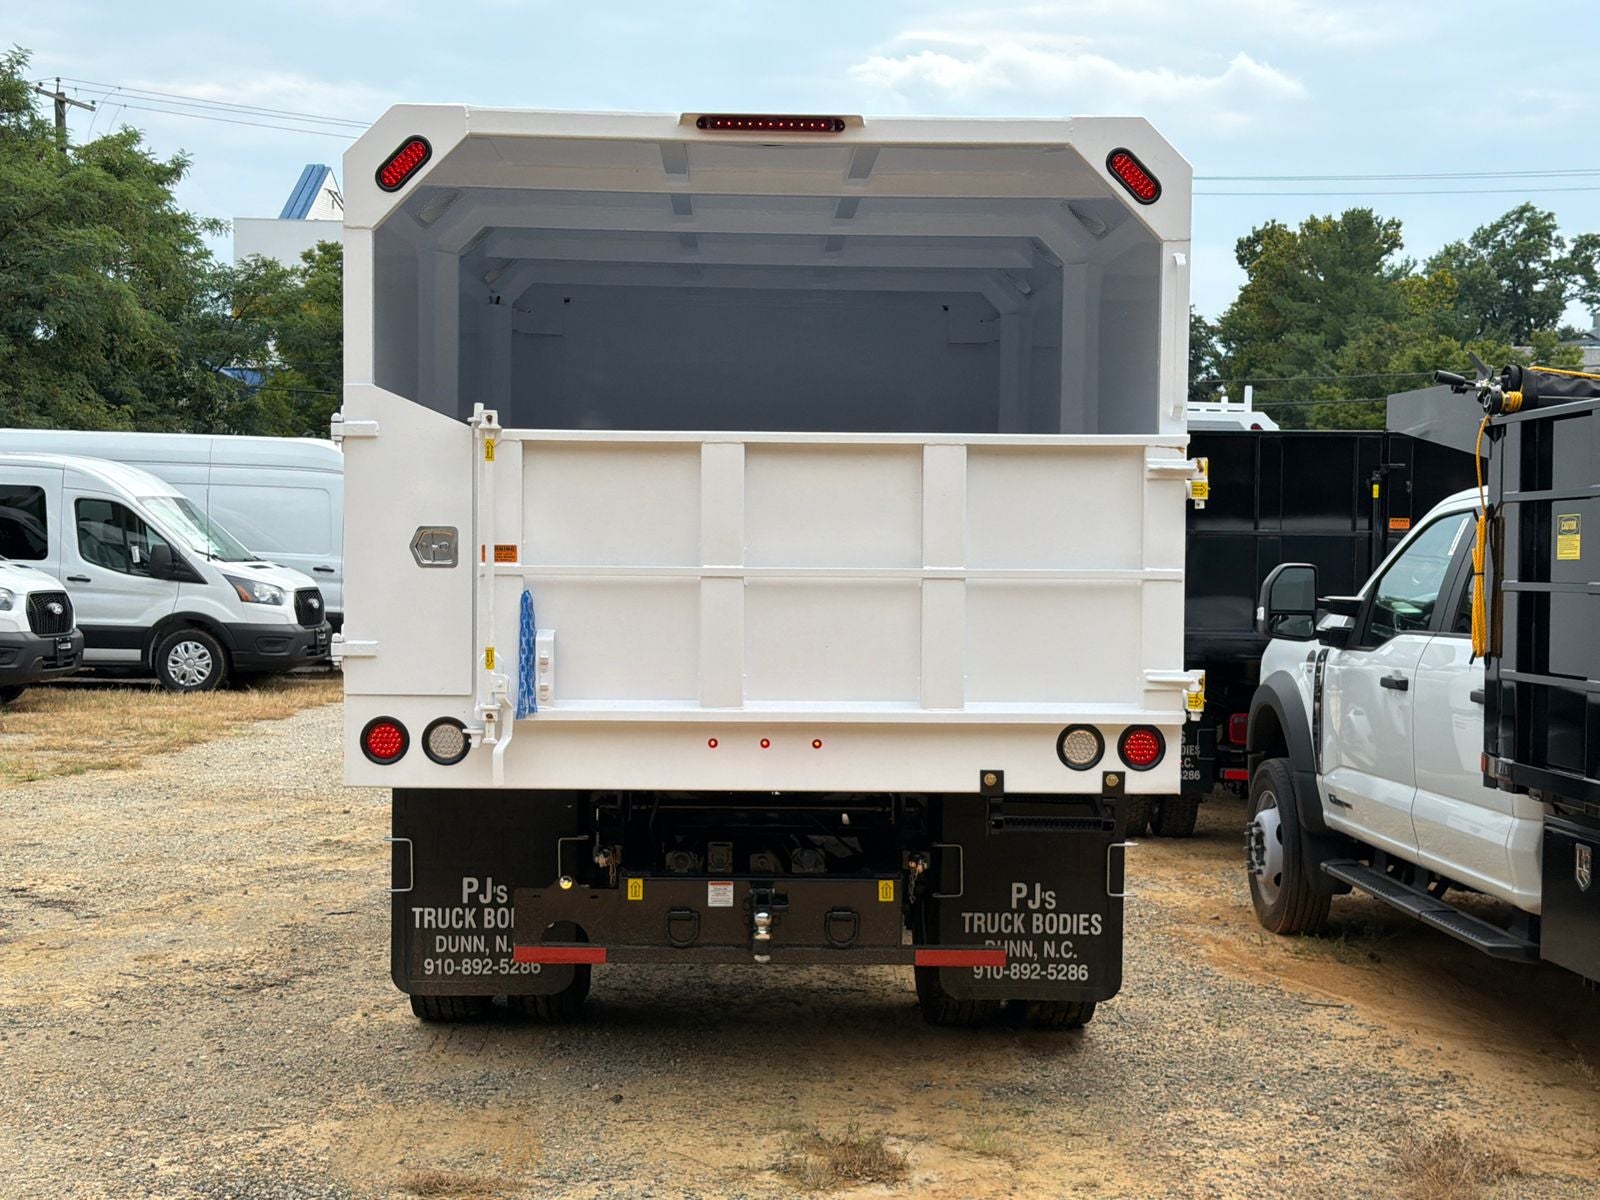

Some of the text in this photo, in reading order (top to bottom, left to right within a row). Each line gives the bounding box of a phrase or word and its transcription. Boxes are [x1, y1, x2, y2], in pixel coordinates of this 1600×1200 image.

[462, 877, 508, 904] PJ's
[1011, 882, 1057, 909] PJ's
[412, 907, 477, 929] TRUCK
[961, 912, 1103, 936] TRUCK BODIES
[435, 935, 490, 956] DUNN,
[1043, 940, 1078, 958] N.C.
[424, 958, 541, 975] 910-892-5286
[973, 963, 1089, 981] 910-892-5286
